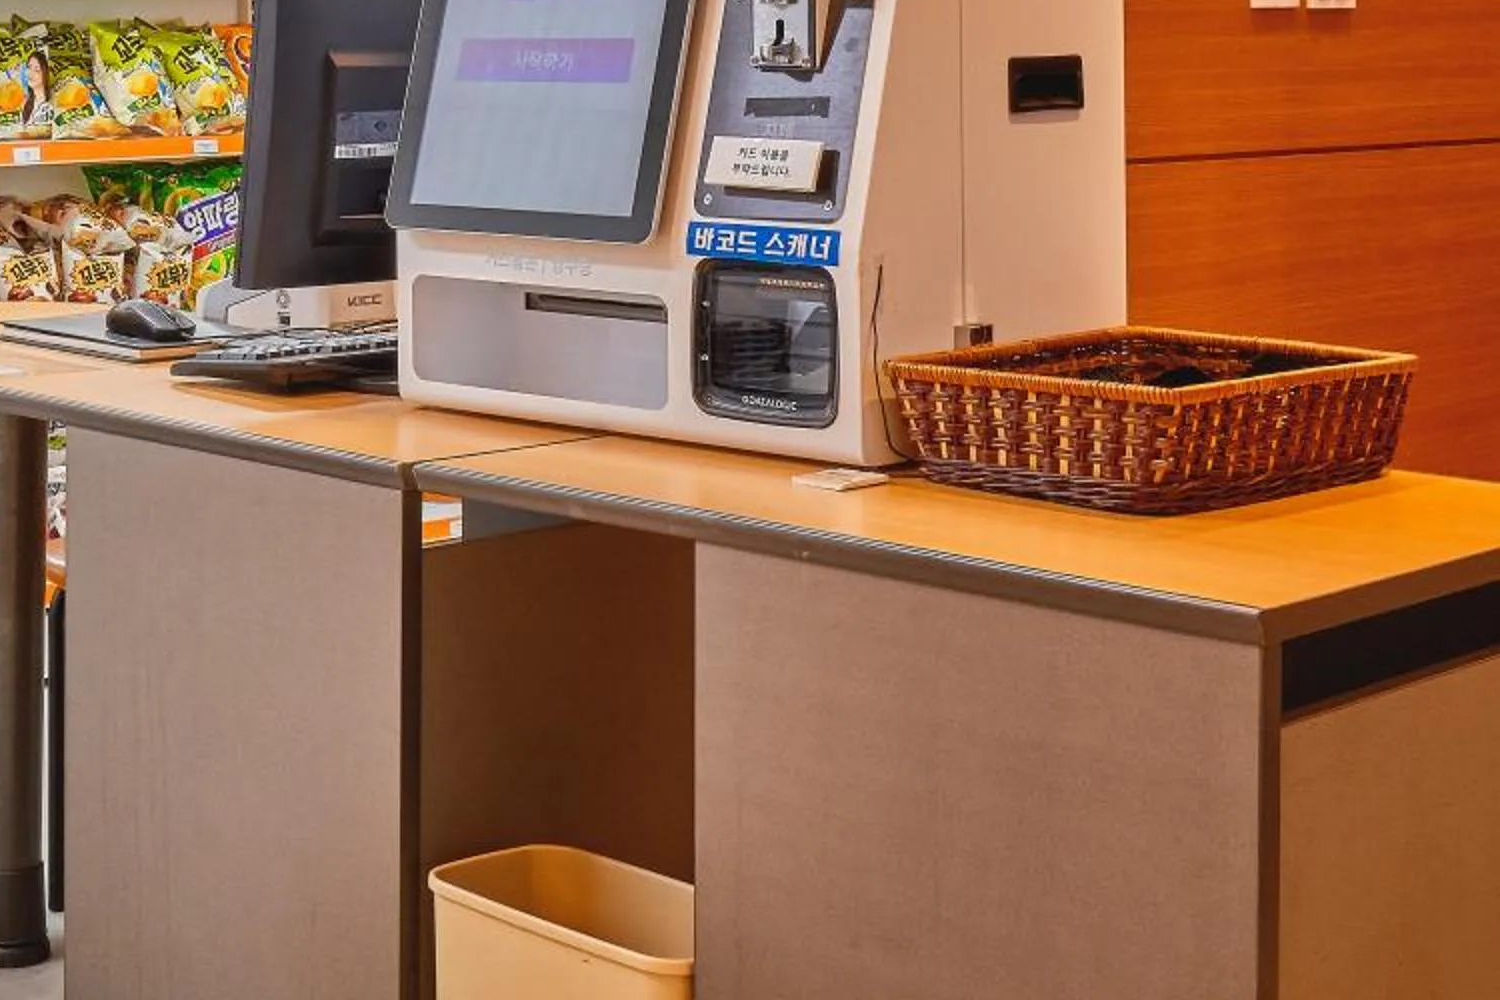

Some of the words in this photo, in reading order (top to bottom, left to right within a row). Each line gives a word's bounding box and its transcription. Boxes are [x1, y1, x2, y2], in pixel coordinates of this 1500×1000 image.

[738, 147, 757, 159] 카드
[694, 227, 758, 255] 바코드
[763, 233, 832, 261] 스캐너
